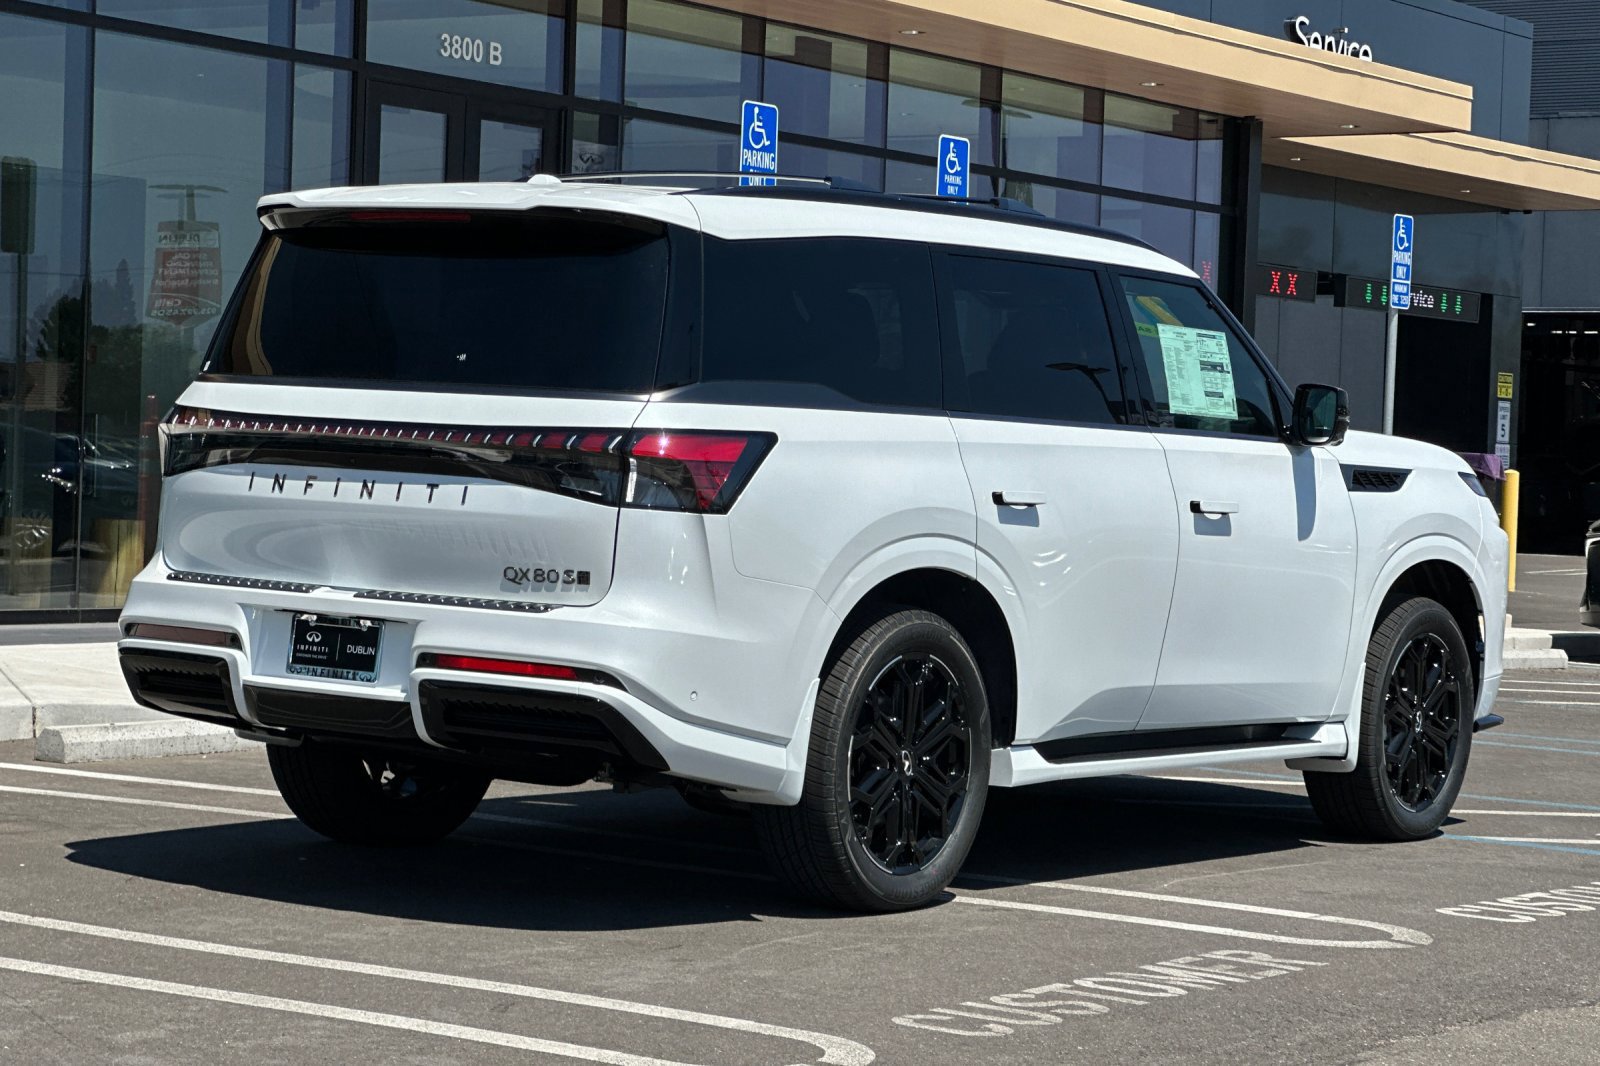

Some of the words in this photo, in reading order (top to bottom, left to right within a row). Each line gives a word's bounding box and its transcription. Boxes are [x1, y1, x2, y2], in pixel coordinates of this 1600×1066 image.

[1296, 15, 1373, 63] Service
[440, 33, 484, 63] 3800
[488, 41, 503, 66] B
[743, 148, 775, 171] PARKING
[944, 174, 962, 186] PARKING
[947, 185, 959, 195] ONLY
[1393, 250, 1411, 266] PARKING
[1396, 265, 1407, 279] ONLY
[249, 470, 469, 506] INFINITI
[503, 566, 560, 586] QX80
[296, 644, 328, 653] INFINITI
[346, 644, 375, 656] DUBLIN
[890, 948, 1330, 1037] CUSTOMER
